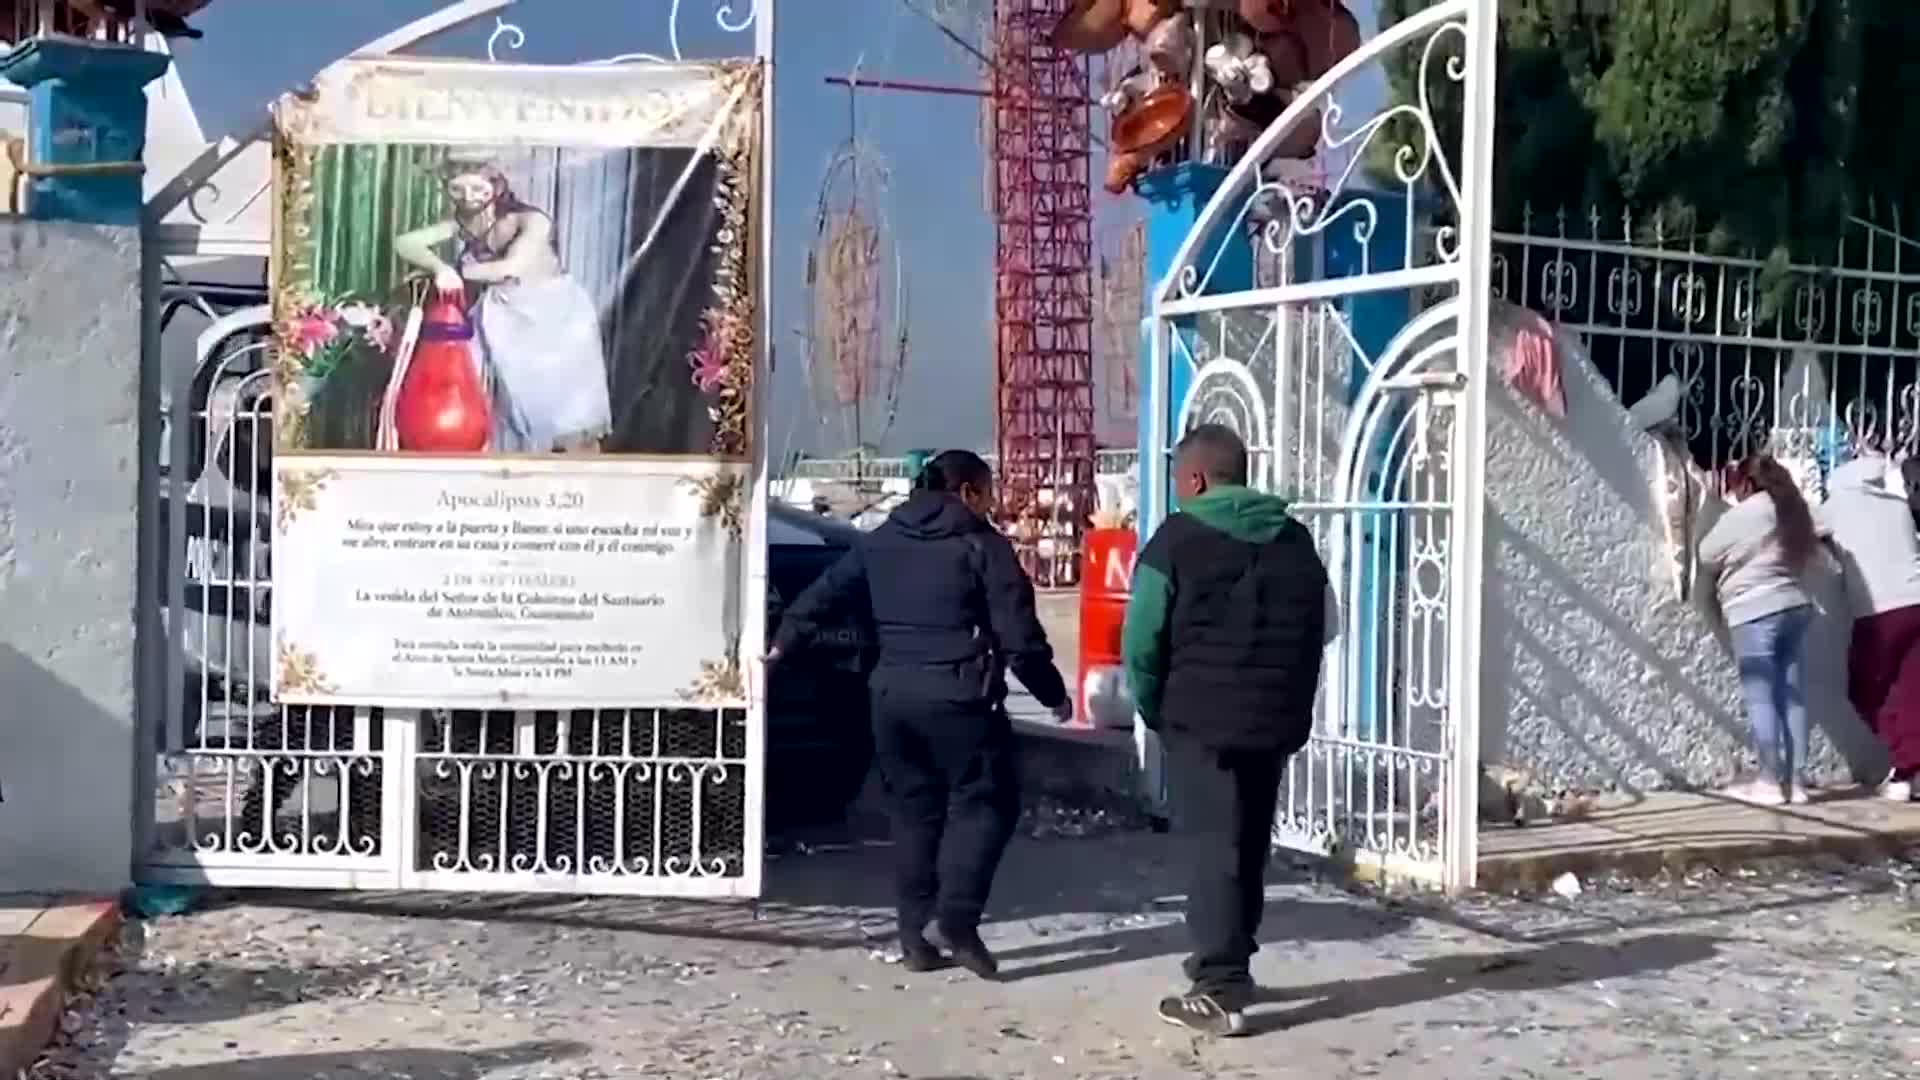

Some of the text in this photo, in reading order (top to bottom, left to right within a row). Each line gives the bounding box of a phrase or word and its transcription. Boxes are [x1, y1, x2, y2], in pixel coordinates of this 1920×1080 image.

[436, 489, 541, 512] Apocalipsis
[377, 521, 399, 537] que
[591, 521, 639, 537] escucha
[355, 589, 370, 602] La
[418, 589, 438, 604] del
